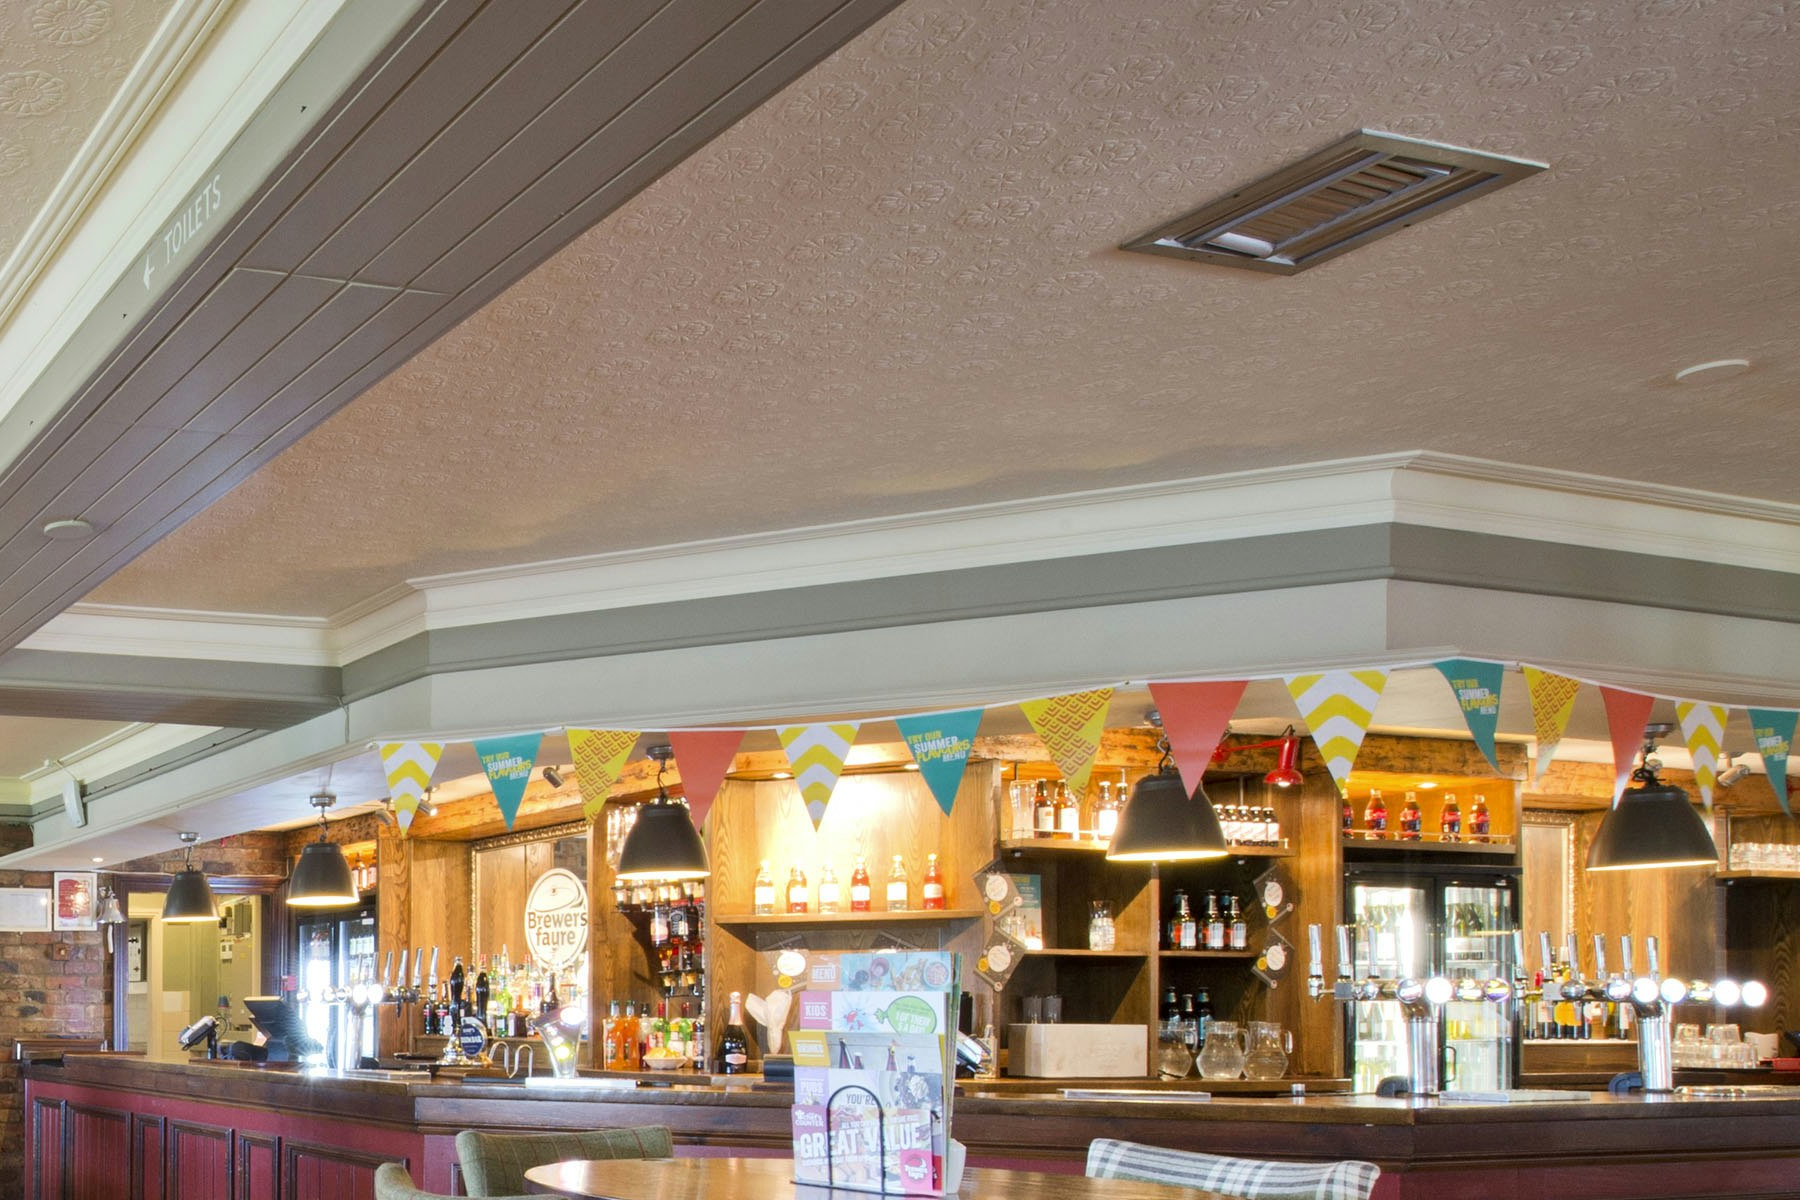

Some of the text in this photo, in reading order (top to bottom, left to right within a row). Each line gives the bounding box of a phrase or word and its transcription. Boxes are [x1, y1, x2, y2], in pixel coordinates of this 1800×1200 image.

[163, 174, 221, 264] TOILETS
[914, 735, 959, 753] SUMMER
[487, 756, 522, 771] SUMMER
[942, 751, 966, 762] MENU
[510, 770, 529, 780] MENU
[527, 911, 588, 929] Brewers
[813, 967, 836, 980] MENU
[805, 1005, 826, 1017] KIDS
[800, 1123, 920, 1158] GREAT VALUE
